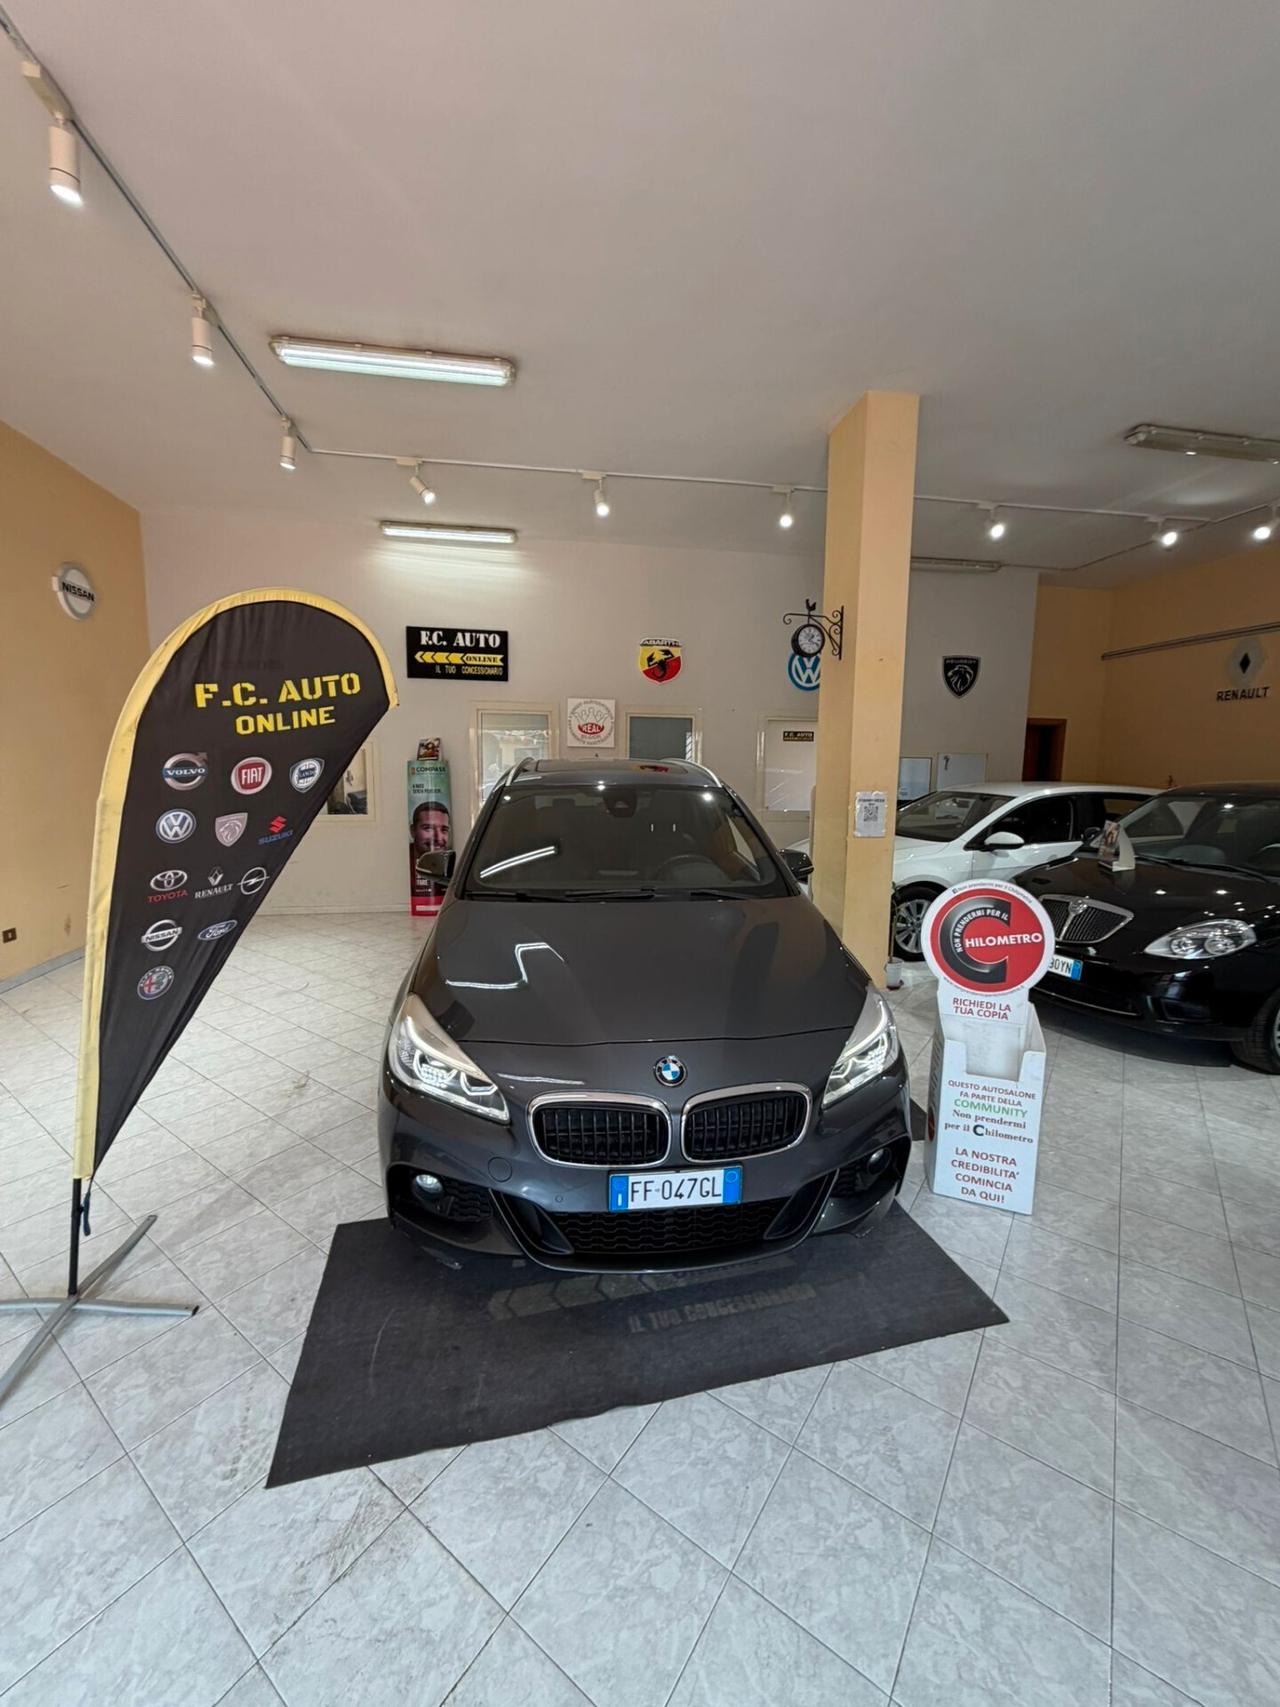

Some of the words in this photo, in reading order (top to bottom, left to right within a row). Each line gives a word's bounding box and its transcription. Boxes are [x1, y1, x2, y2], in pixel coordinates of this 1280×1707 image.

[62, 581, 95, 602] NISSAN
[420, 630, 447, 646] F.C.
[453, 632, 501, 648] AUTO
[465, 655, 499, 663] ONLINE
[445, 665, 456, 674] TUO
[194, 682, 268, 708] F.C.
[278, 672, 361, 703] AUTO
[1216, 686, 1271, 702] RENAULT
[235, 706, 335, 735] ONLINE
[165, 767, 206, 776] VOLVO
[241, 767, 264, 785] FIAT
[147, 889, 188, 904] TOYOTA
[194, 883, 234, 899] RENAULT
[954, 908, 985, 937] PRENDERMI
[986, 908, 1001, 917] PER
[145, 928, 180, 942] NISSAN
[965, 932, 1043, 948] HILOMETRO
[952, 997, 996, 1010] RICHIEDI
[1000, 1003, 1012, 1012] LA
[954, 1006, 974, 1016] TUA
[977, 1009, 1009, 1020] COPIA
[948, 1080, 981, 1091] QUESTO
[981, 1083, 1036, 1100] AUTOSALONE
[959, 1090, 969, 1098] FA
[971, 1092, 995, 1103] PARTE
[997, 1096, 1023, 1107] DELLA
[953, 1098, 1028, 1118] COMMUNITY
[944, 1121, 960, 1131] per
[963, 1123, 971, 1132] il
[952, 1109, 972, 1120] Non
[974, 1114, 1027, 1129] prendermi
[955, 1146, 969, 1157] LA
[971, 1149, 1017, 1166] NOSTRA
[955, 1172, 1013, 1192] COMINCIA
[960, 1186, 976, 1197] DA
[979, 1190, 1005, 1204] QUI!
